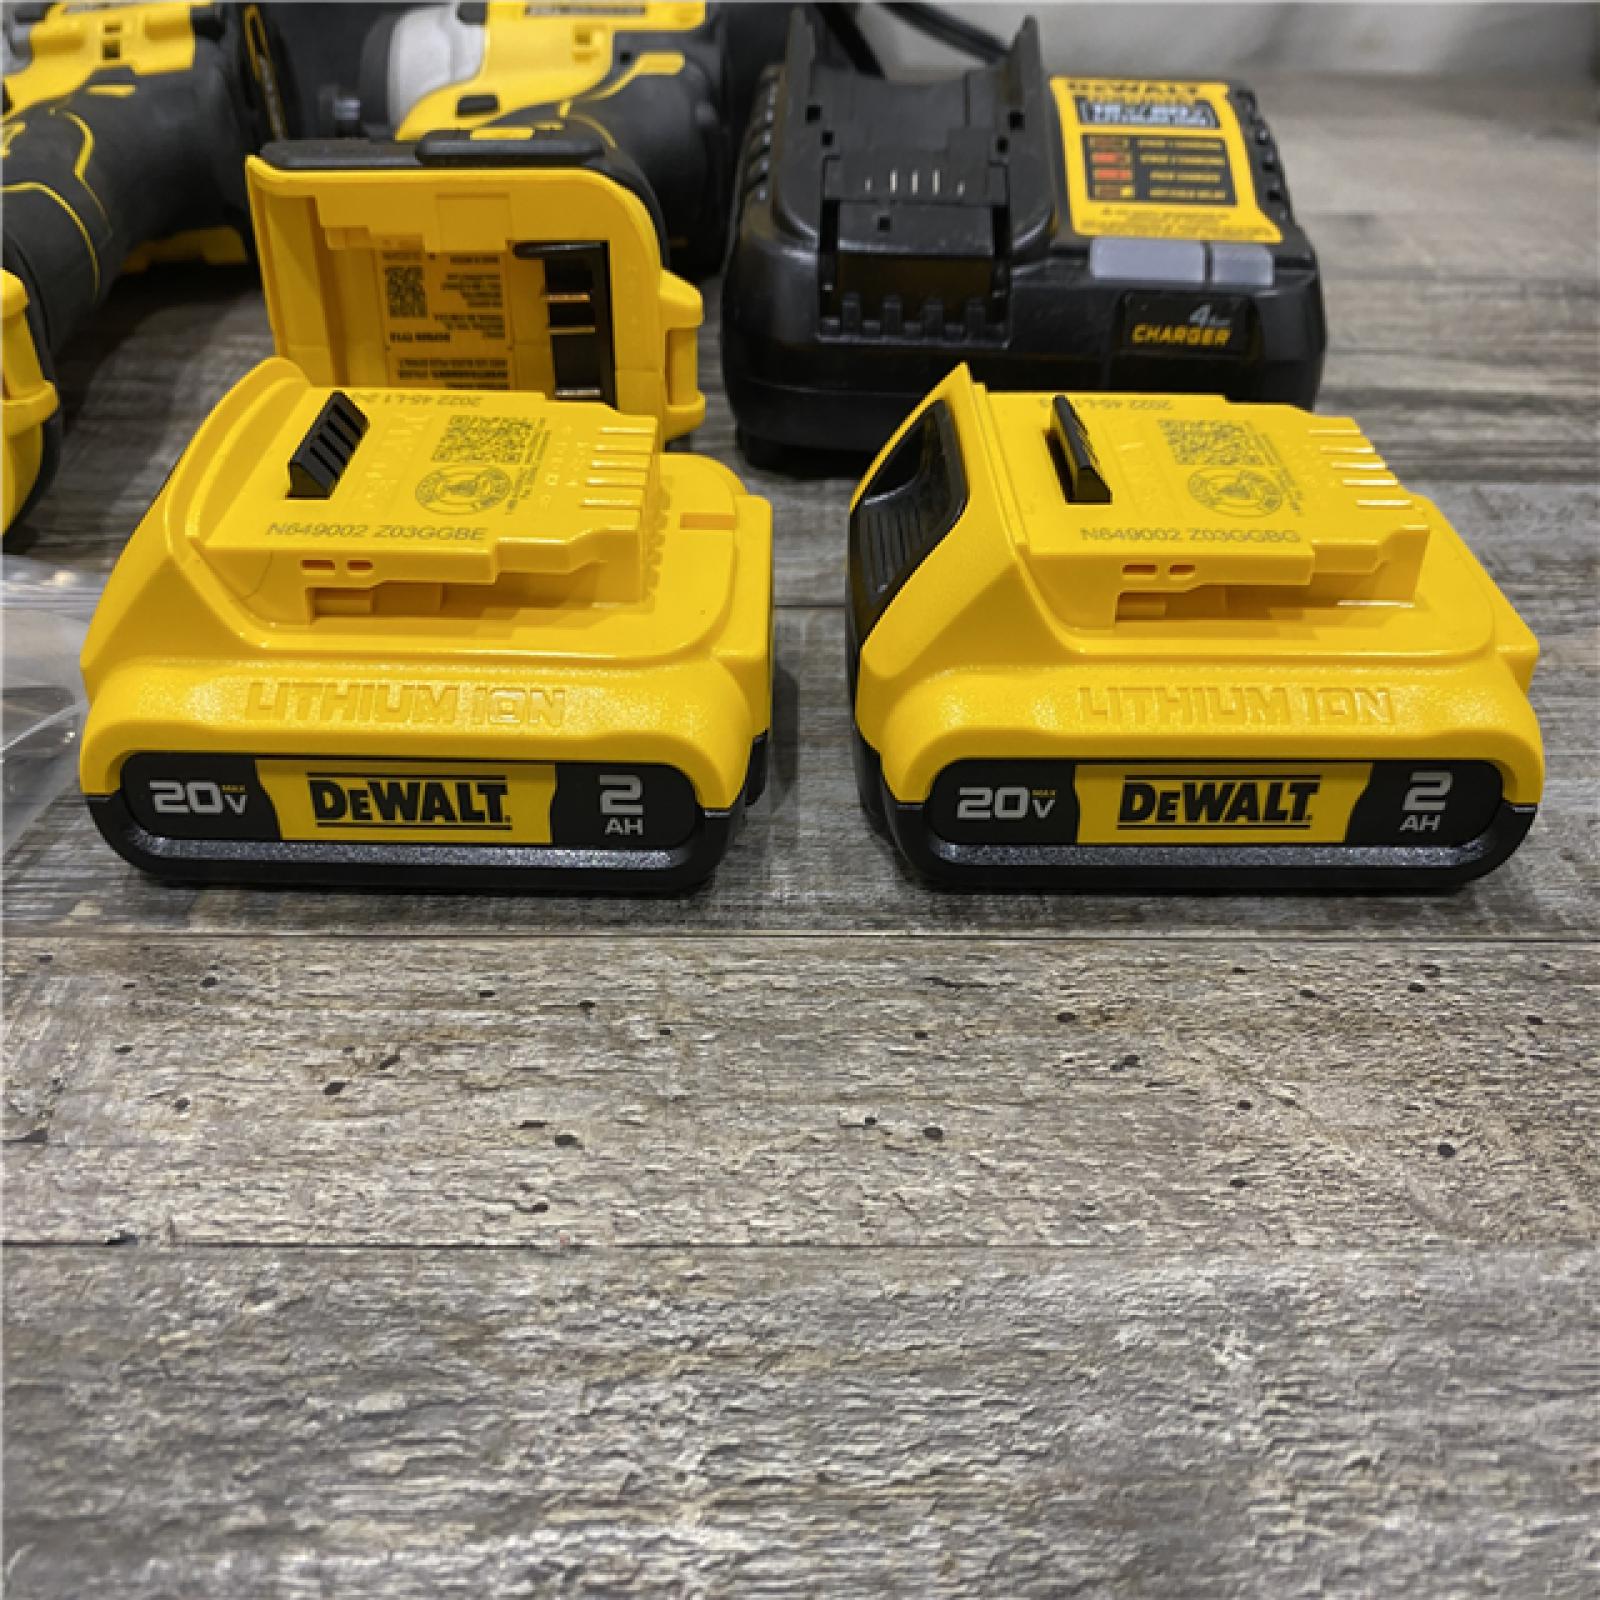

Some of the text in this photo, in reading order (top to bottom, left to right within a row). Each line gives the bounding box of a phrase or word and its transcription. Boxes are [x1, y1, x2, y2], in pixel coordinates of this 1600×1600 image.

[1132, 324, 1231, 346] CHARGER
[246, 681, 567, 726] LITHIUM ION
[1078, 686, 1396, 726] LITHIUM ION
[308, 779, 511, 823] DEWALT
[600, 774, 643, 816] 2
[1119, 782, 1320, 823] DEWALT
[1402, 771, 1453, 811] 2
[604, 817, 643, 836] AH
[1400, 814, 1441, 831] AH
